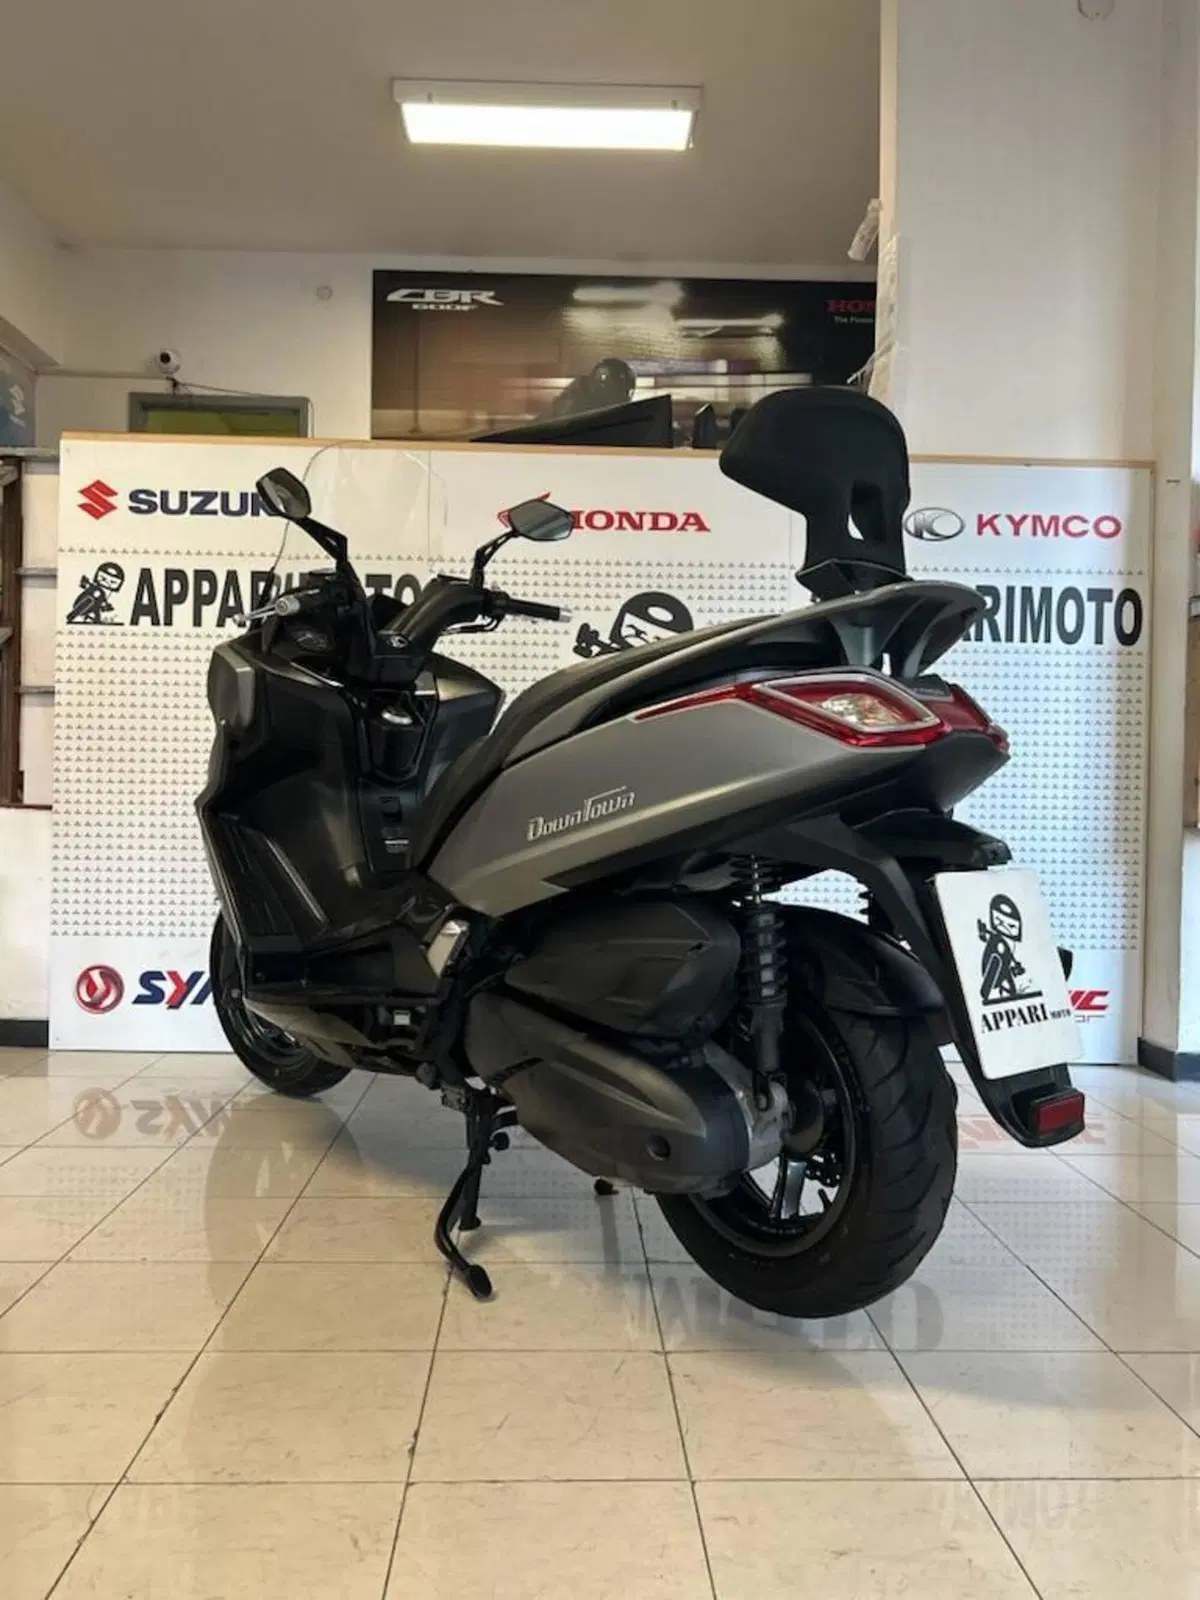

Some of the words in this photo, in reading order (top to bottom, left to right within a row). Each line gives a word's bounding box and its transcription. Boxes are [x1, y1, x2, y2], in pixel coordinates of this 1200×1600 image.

[387, 288, 504, 305] CBR
[128, 489, 284, 517] SUZUK
[976, 513, 1122, 539] KYMCO
[962, 585, 1143, 647] RIMOTO
[132, 970, 213, 1010] SY
[980, 1002, 1048, 1034] APPARI
